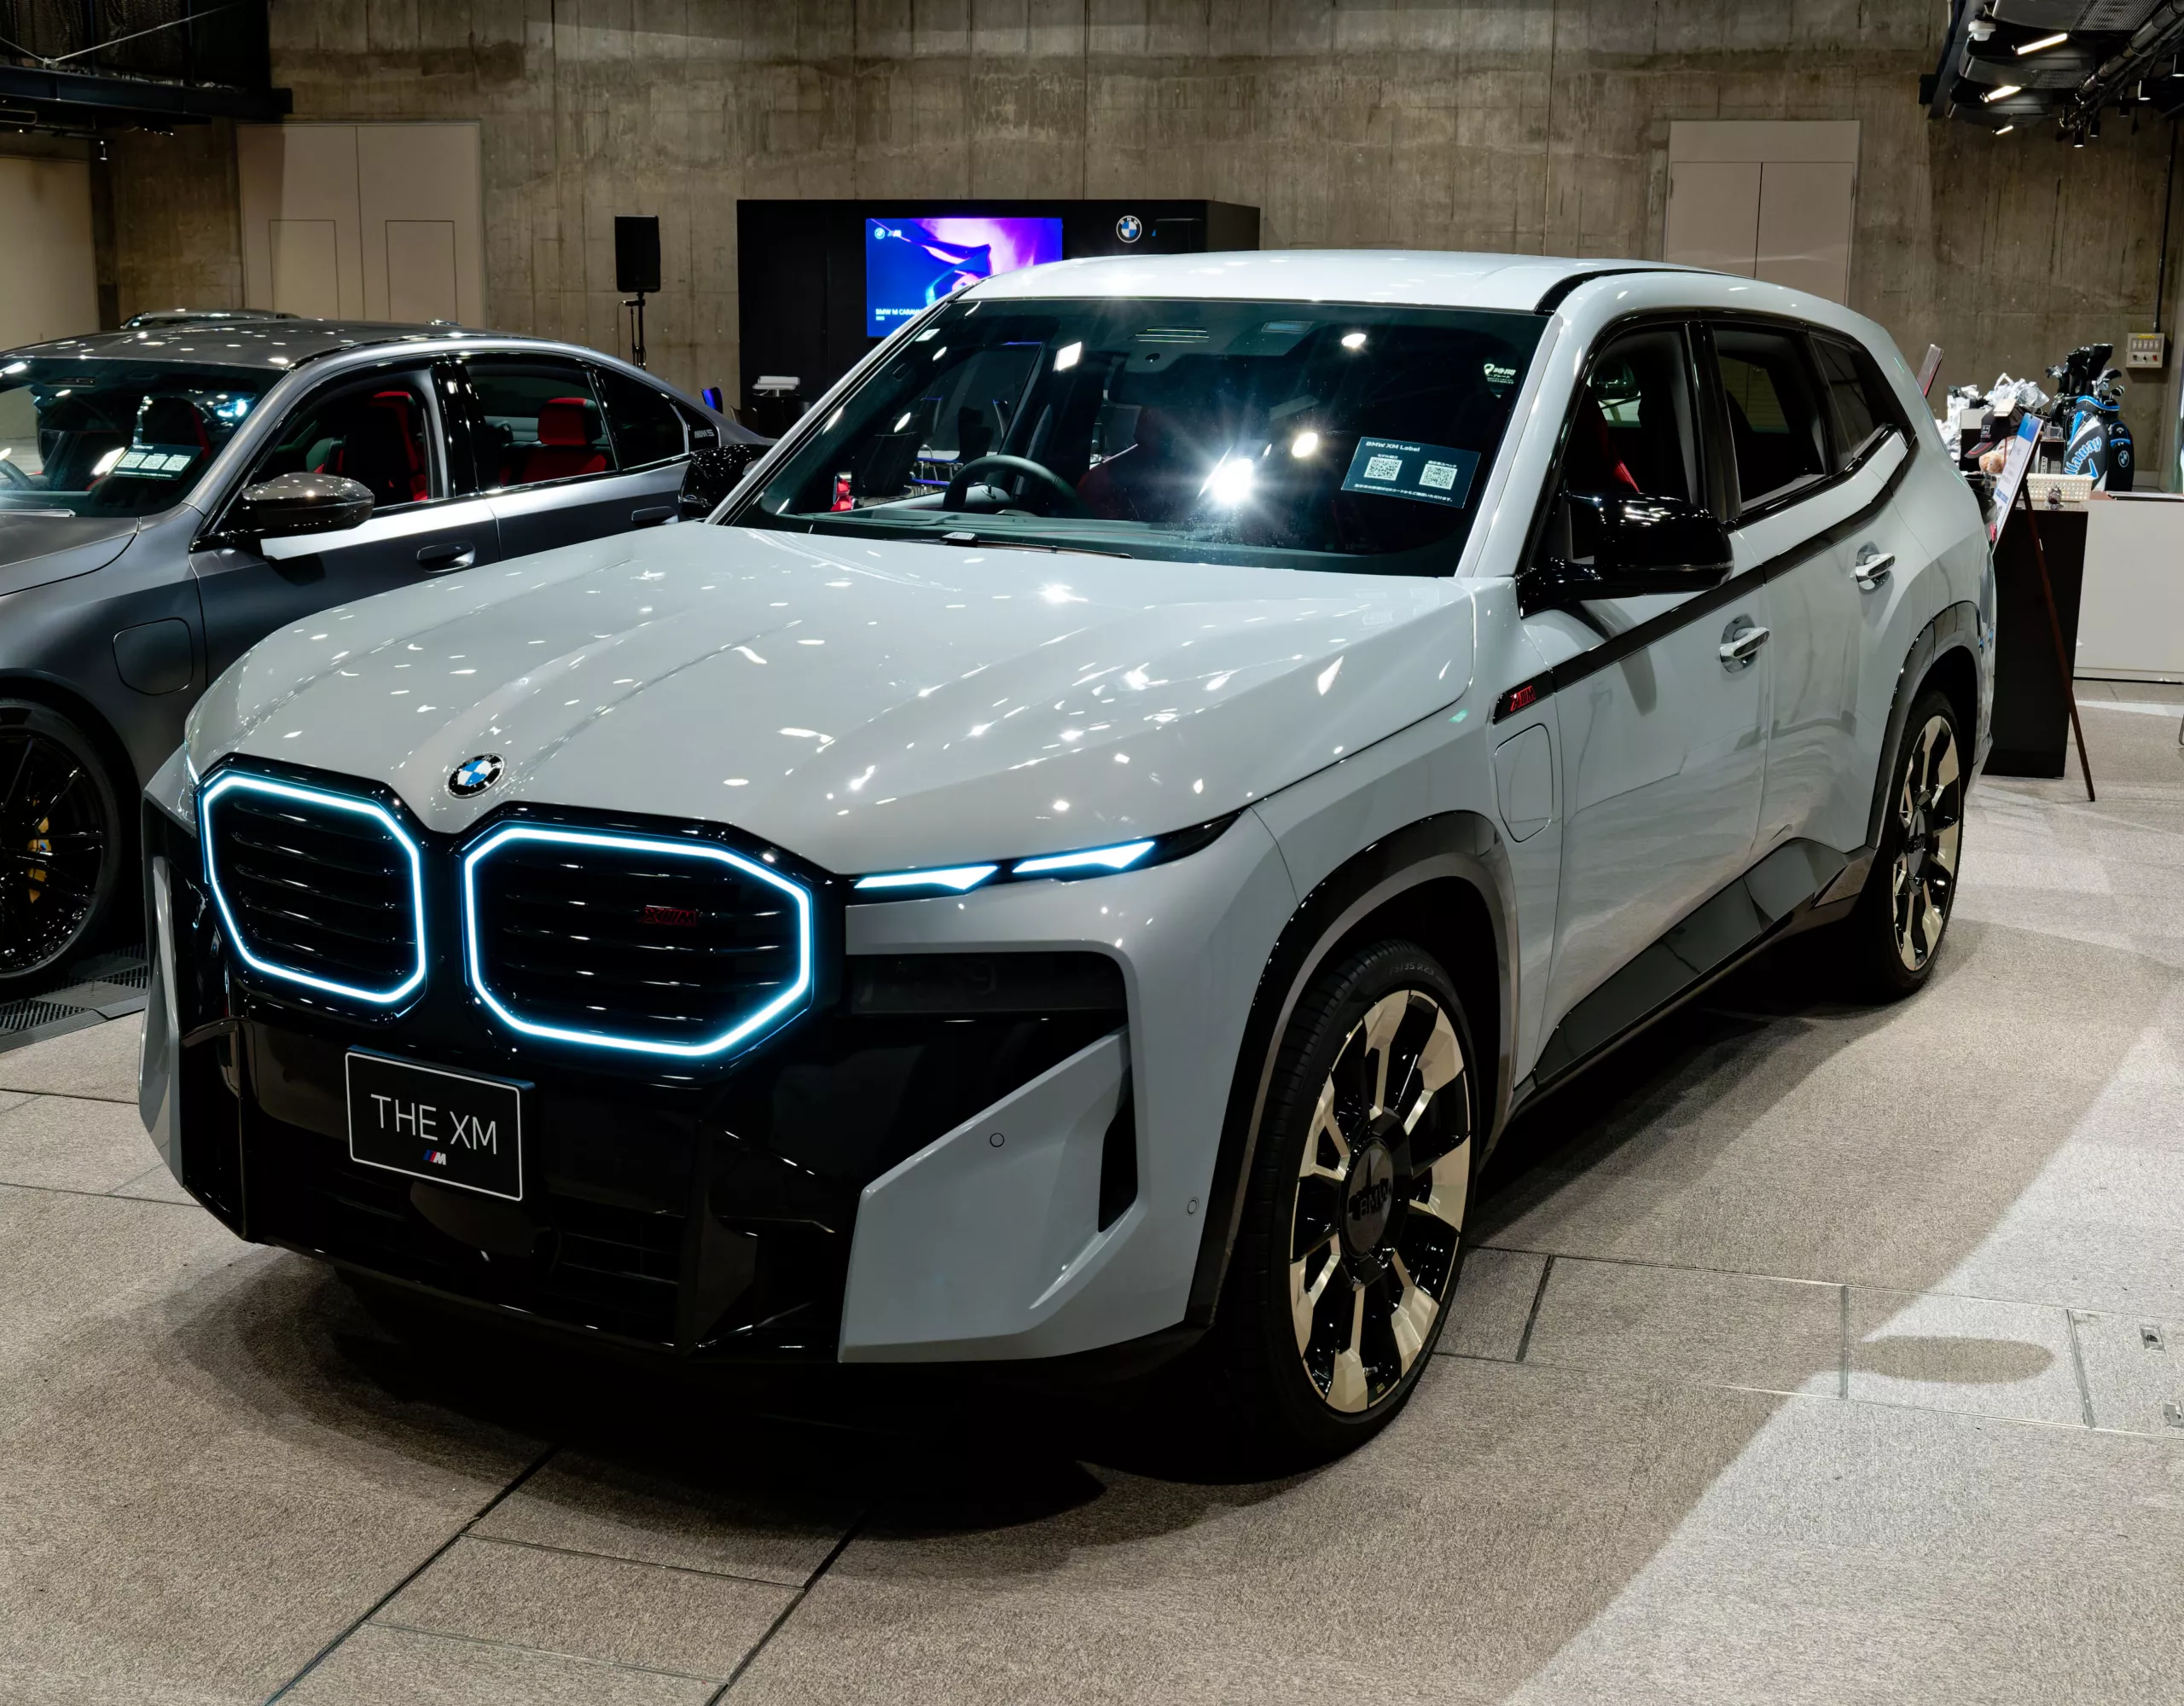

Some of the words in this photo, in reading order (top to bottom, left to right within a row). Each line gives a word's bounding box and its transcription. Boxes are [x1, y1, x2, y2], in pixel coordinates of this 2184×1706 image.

[2065, 436, 2102, 475] llaway
[370, 1094, 439, 1141] THE
[450, 1111, 497, 1155] XM
